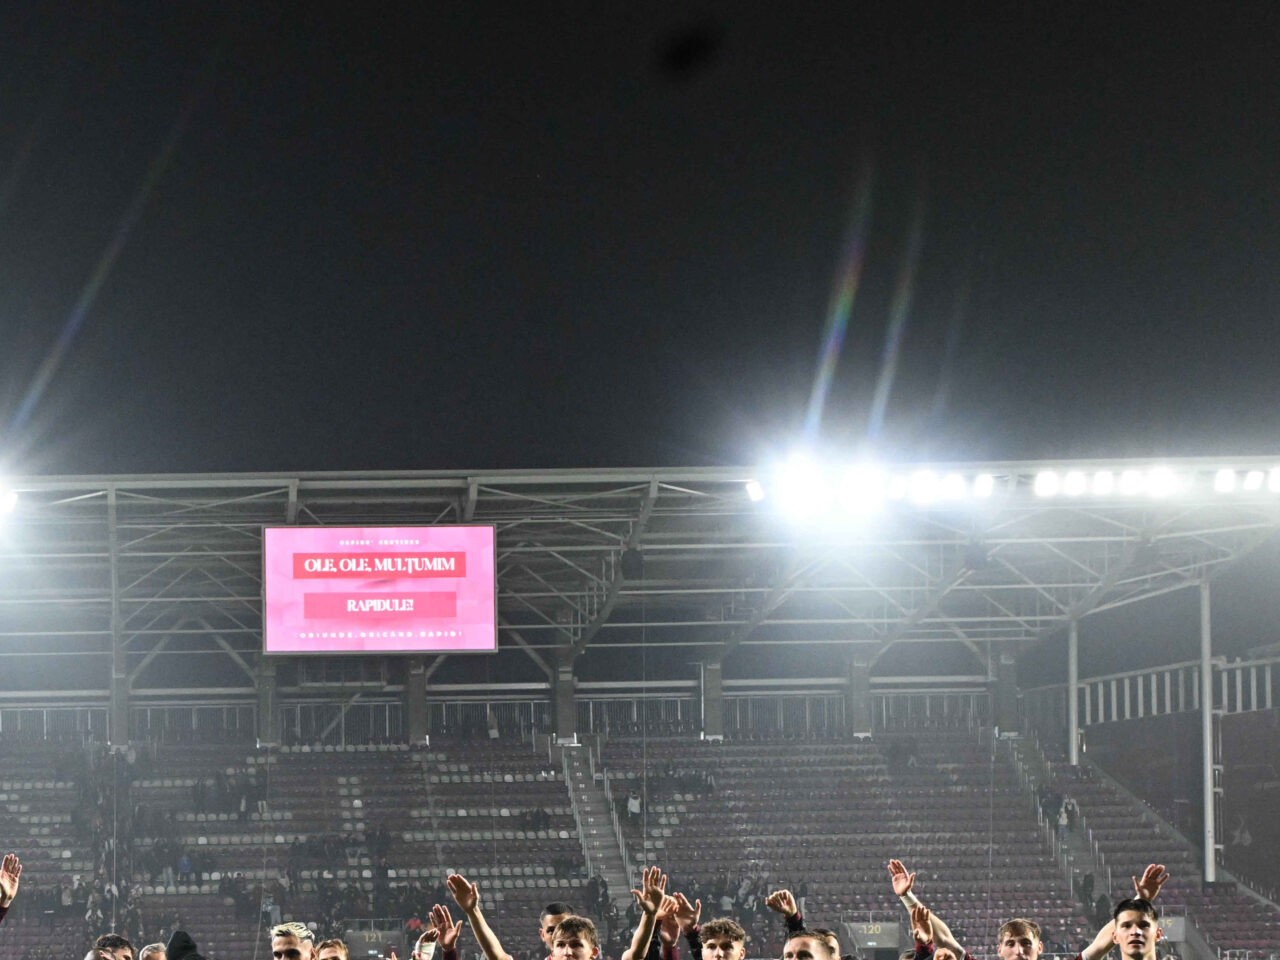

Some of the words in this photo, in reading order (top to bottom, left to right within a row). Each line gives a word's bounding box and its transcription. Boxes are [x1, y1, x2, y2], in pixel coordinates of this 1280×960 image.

[304, 558, 337, 573] OLE,
[339, 558, 372, 572] OLE,
[347, 599, 414, 612] RAPIDULE!
[861, 924, 881, 934] 120
[362, 932, 382, 943] 121
